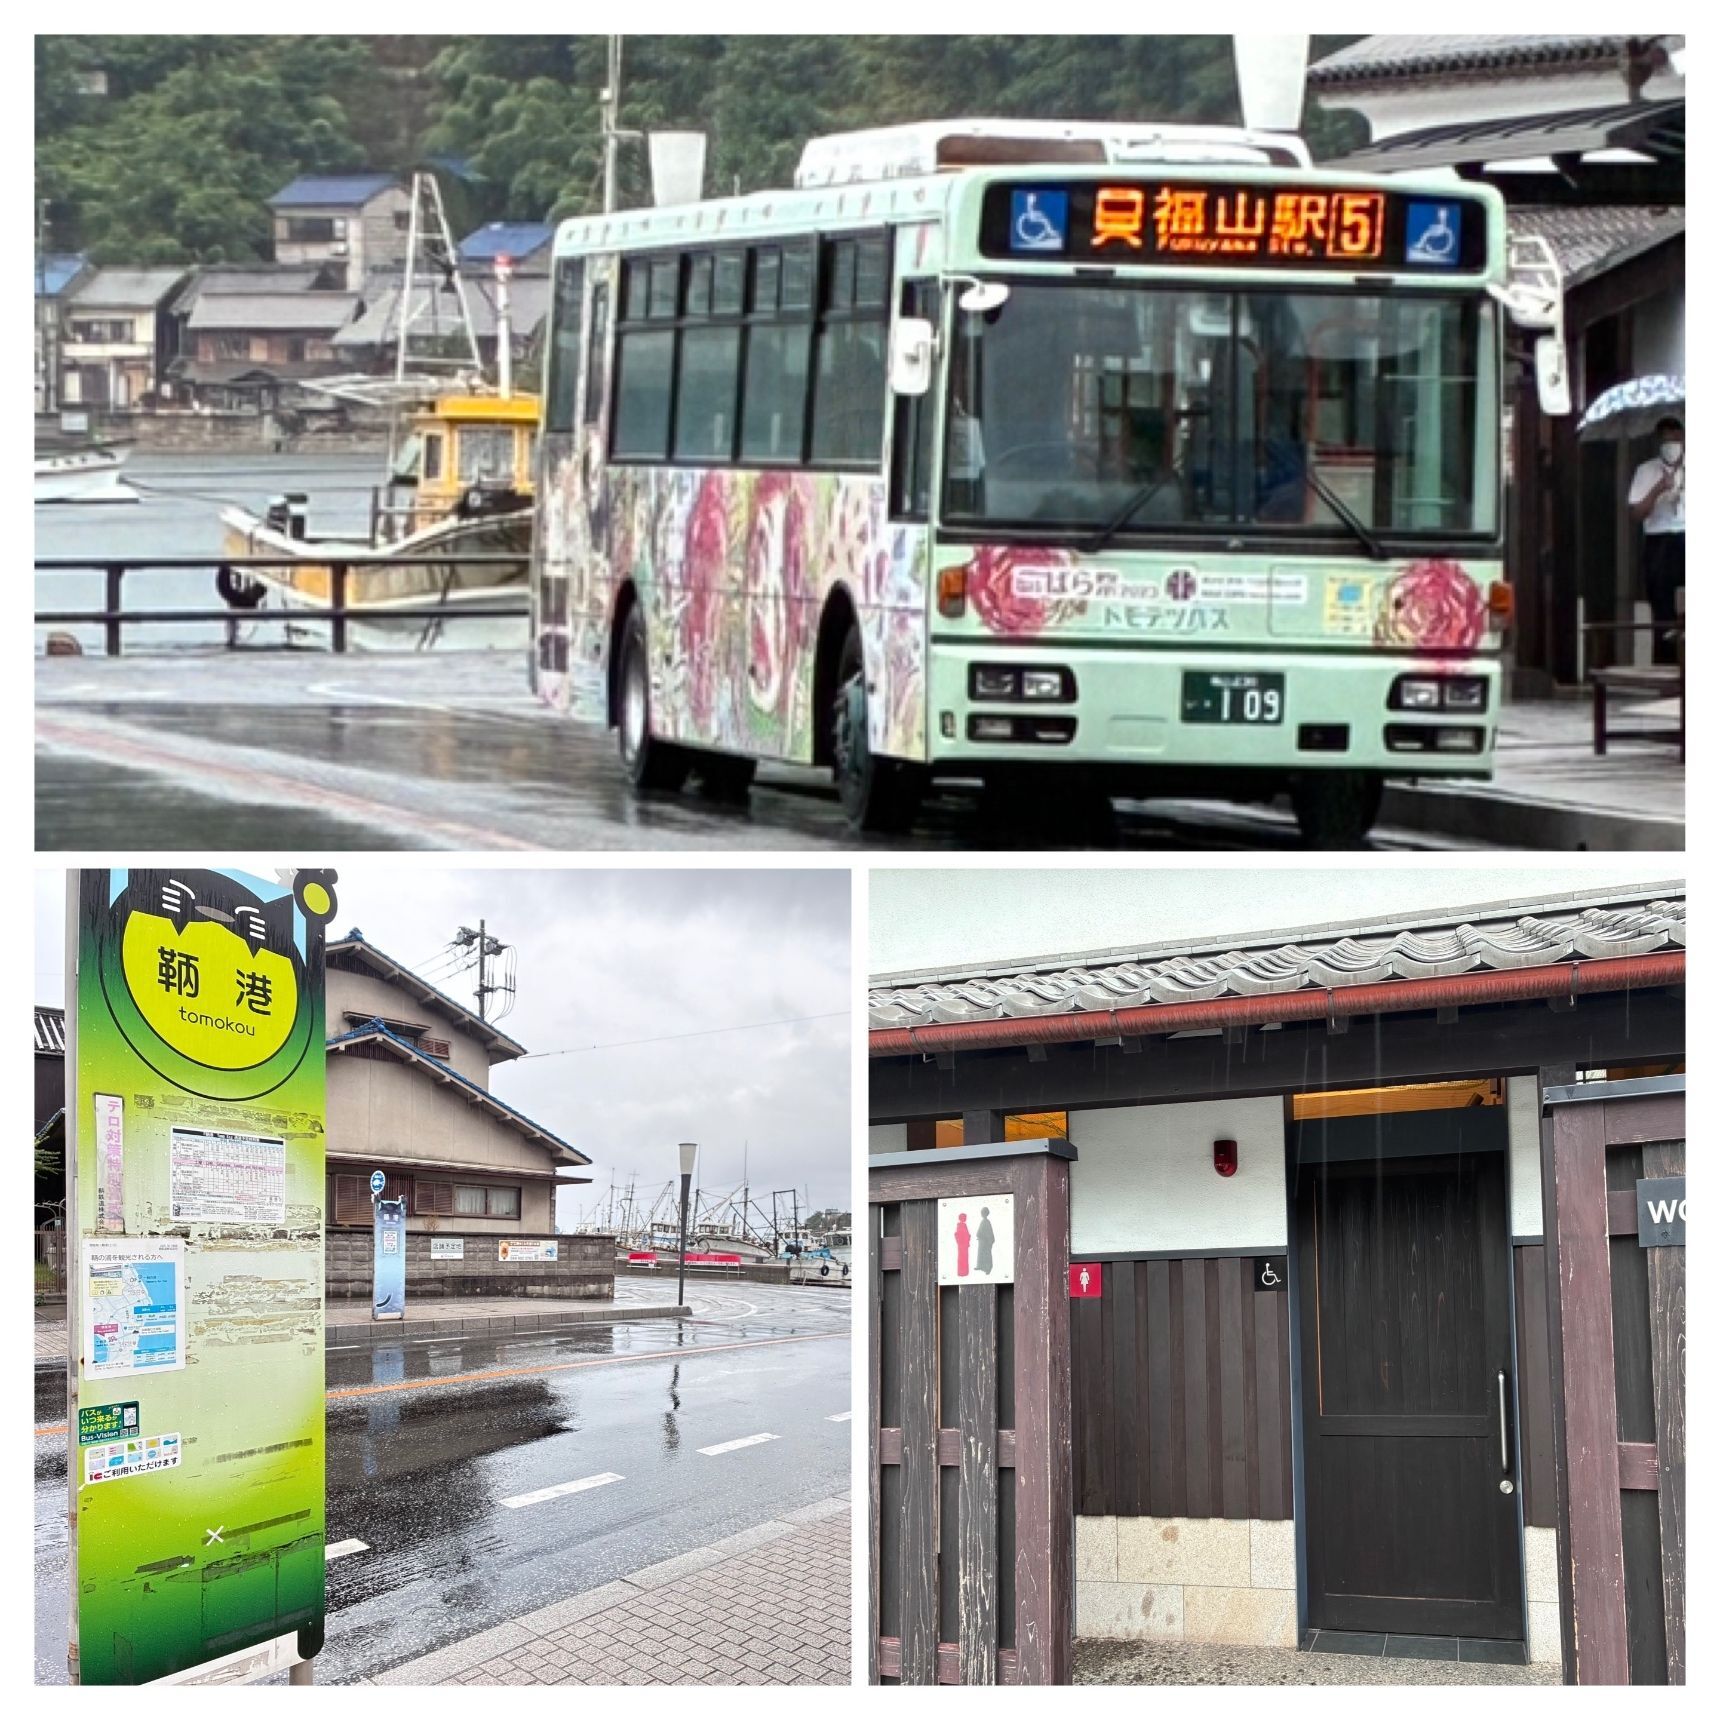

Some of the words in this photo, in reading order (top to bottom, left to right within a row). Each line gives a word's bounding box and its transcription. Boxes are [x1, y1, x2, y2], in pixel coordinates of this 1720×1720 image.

[1338, 197, 1372, 252] 5
[178, 1005, 255, 1036] tomokou
[1647, 1199, 1687, 1224] W
